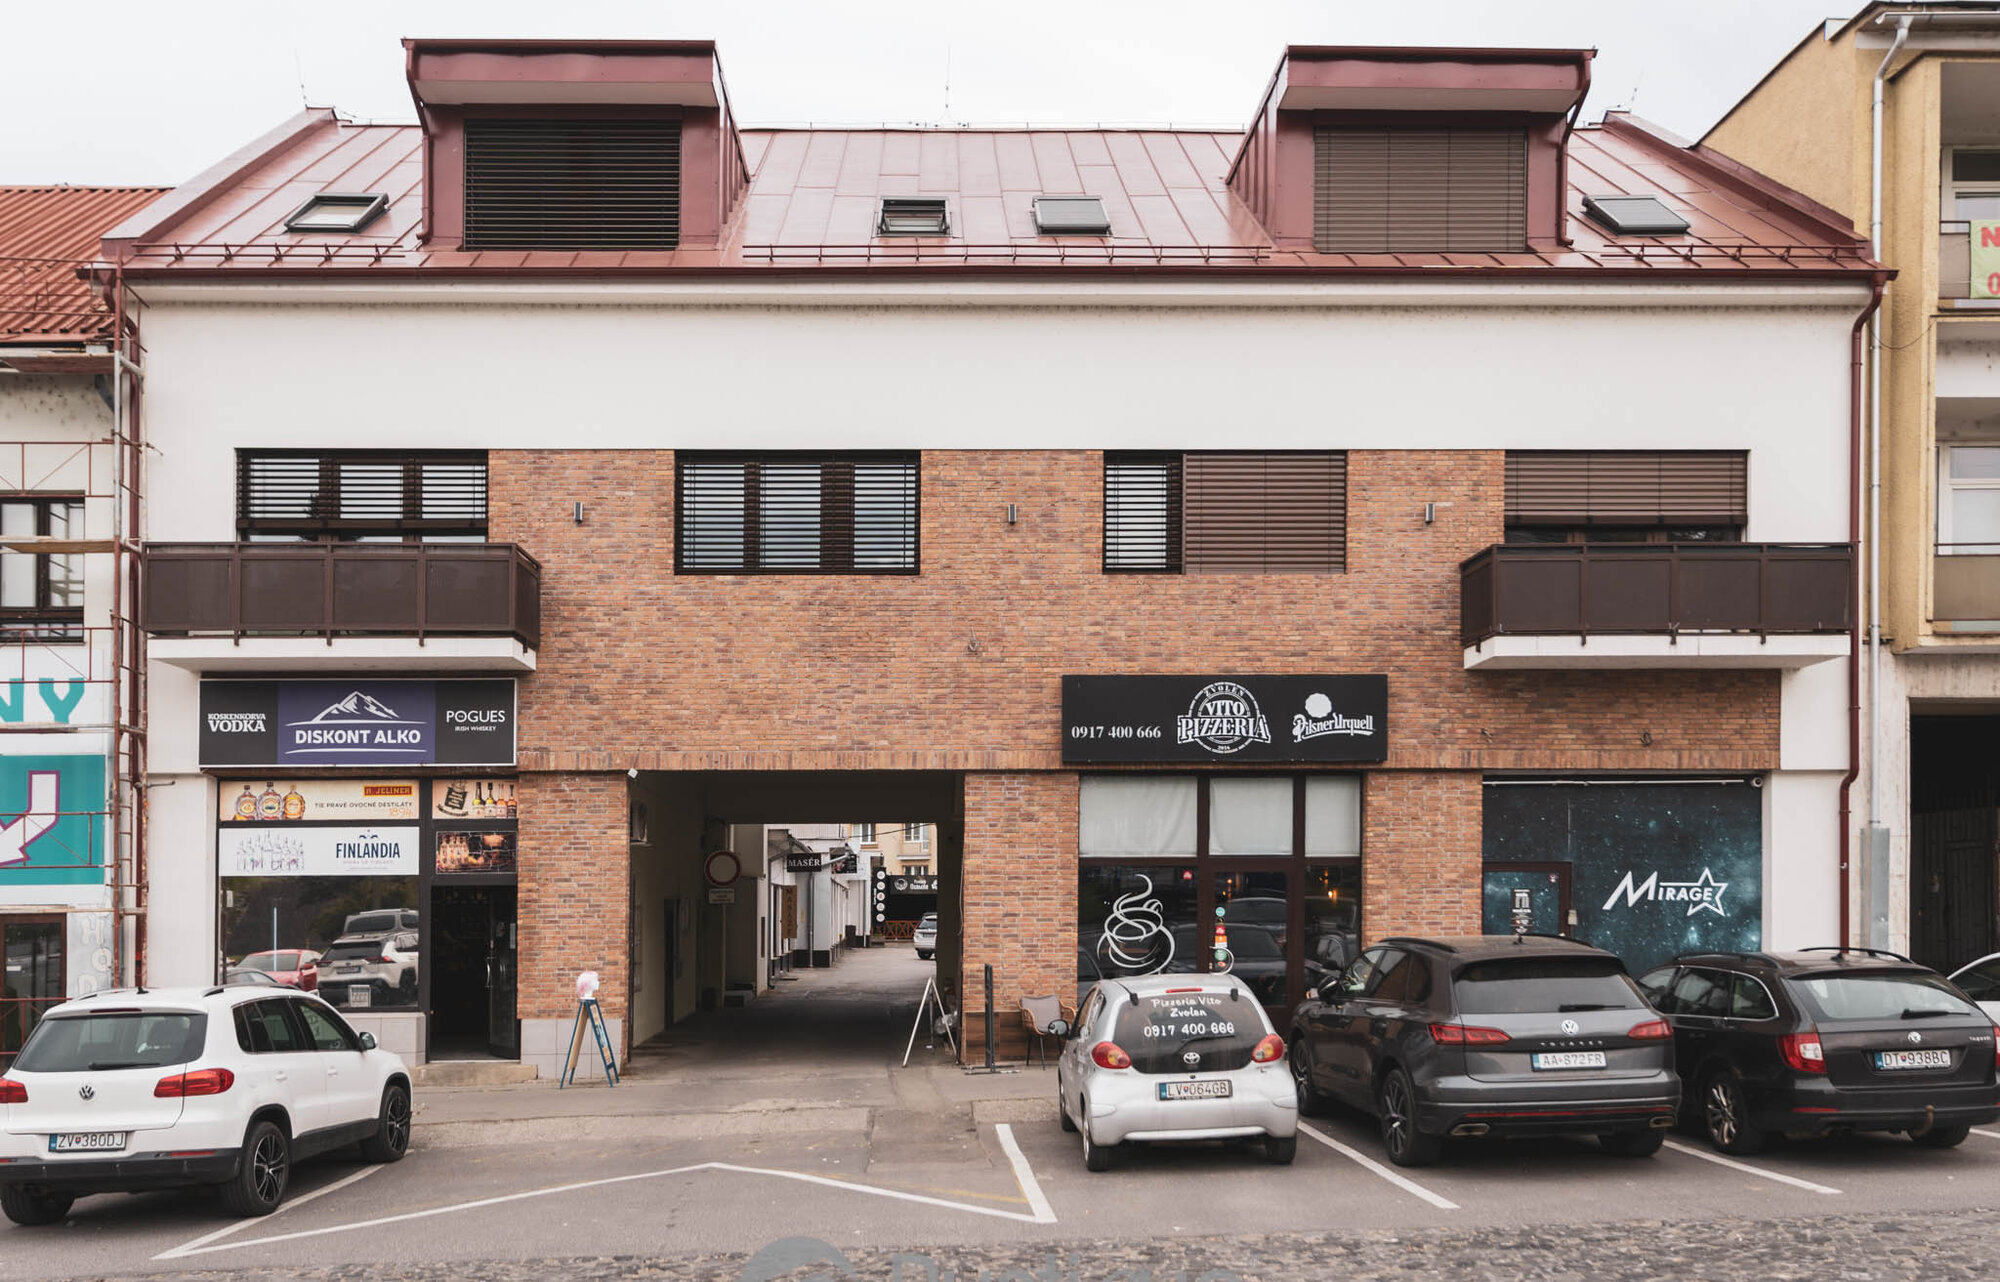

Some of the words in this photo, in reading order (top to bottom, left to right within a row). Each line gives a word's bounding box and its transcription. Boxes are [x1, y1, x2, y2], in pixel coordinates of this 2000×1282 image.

[1203, 684, 1245, 697] ZVOLEN
[1205, 699, 1245, 716] VITO
[207, 712, 266, 721] KOSKENKORVA
[446, 709, 506, 723] POGUES
[208, 719, 266, 732] VODKA
[1071, 725, 1104, 739] 0917
[1107, 725, 1133, 739] 400
[1136, 725, 1162, 739] 666
[1180, 717, 1267, 741] PIZZERIA
[1292, 713, 1335, 743] Pilsner
[1332, 712, 1374, 736] Urquell
[295, 729, 371, 744] DISKONT
[373, 729, 421, 744] ALKO
[335, 842, 401, 859] FINLANDIA
[788, 857, 820, 867] MASÉR
[1151, 998, 1197, 1008] Pizzeria
[1198, 996, 1222, 1005] Vito
[1170, 1007, 1207, 1018] Zvolen
[1143, 1024, 1176, 1038] 0917
[1181, 1023, 1206, 1035] 400
[1210, 1021, 1235, 1034] 666
